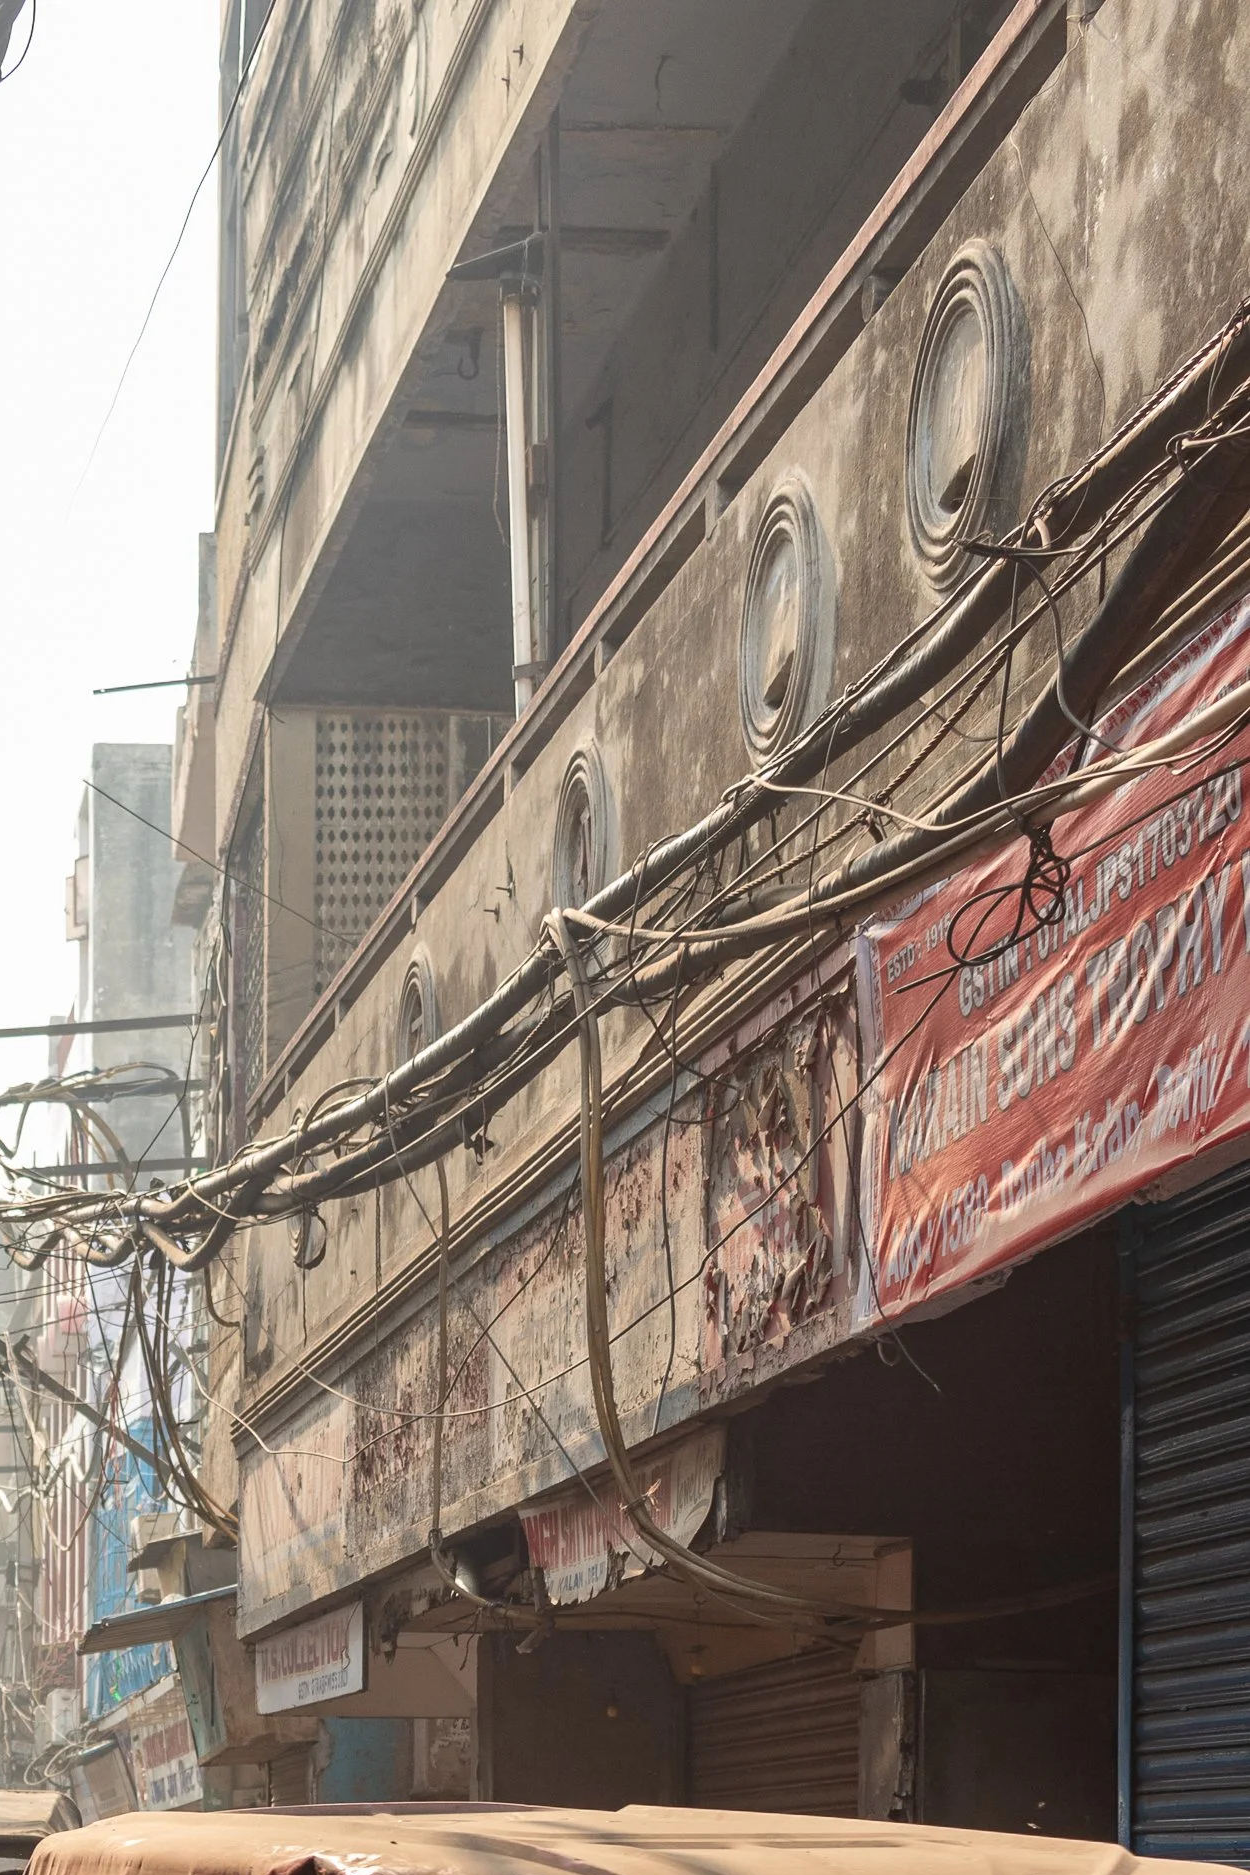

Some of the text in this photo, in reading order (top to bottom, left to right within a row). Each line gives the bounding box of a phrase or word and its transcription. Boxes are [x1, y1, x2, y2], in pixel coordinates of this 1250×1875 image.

[888, 1040, 988, 1181] NARAIN
[997, 973, 1077, 1111] SONS
[1085, 861, 1232, 1052] TROPHY
